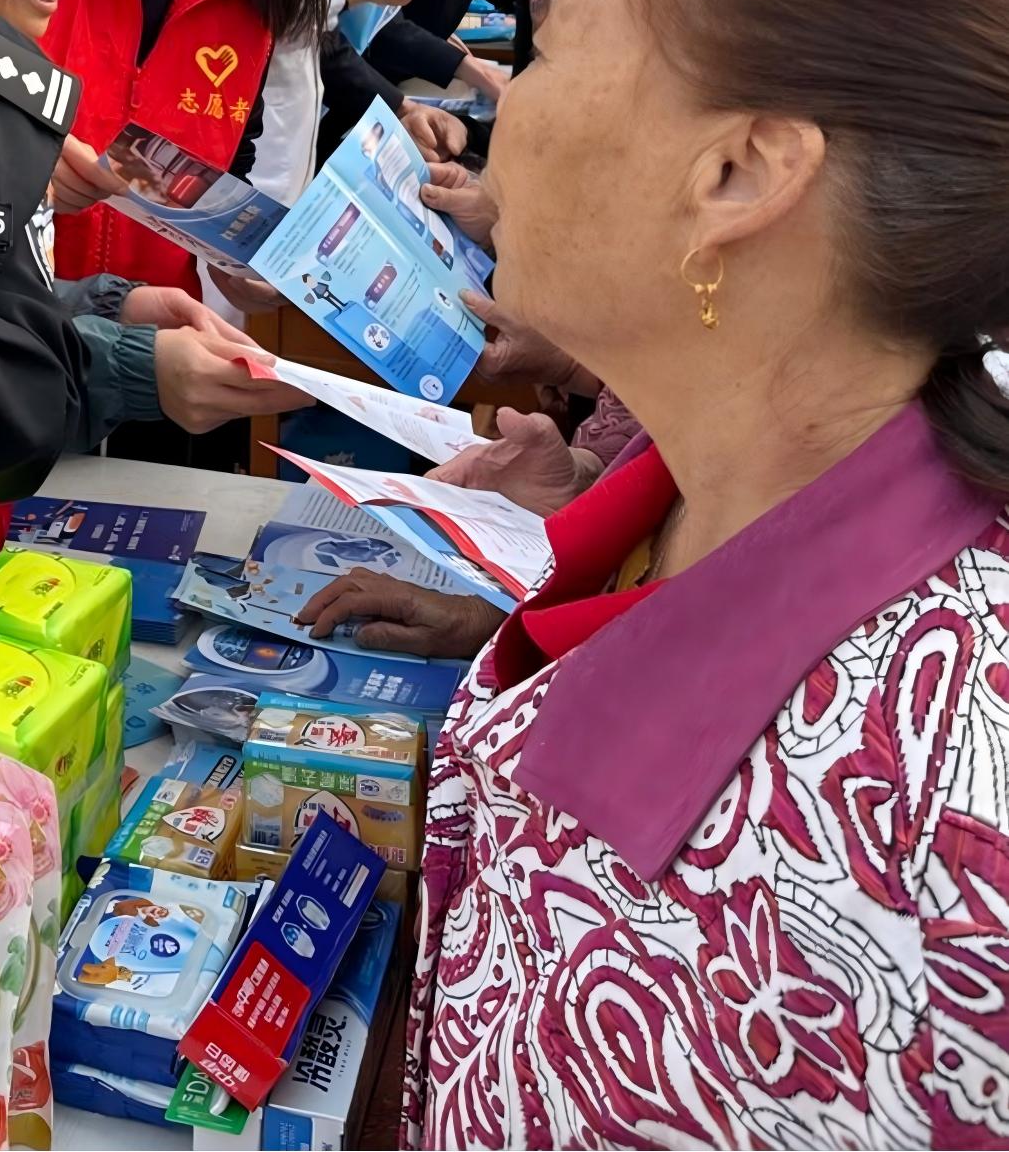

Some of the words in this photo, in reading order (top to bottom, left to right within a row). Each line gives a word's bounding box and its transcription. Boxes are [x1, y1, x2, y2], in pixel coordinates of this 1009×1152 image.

[177, 88, 250, 124] 志愿者
[292, 1013, 347, 1092] 冷酸灵
